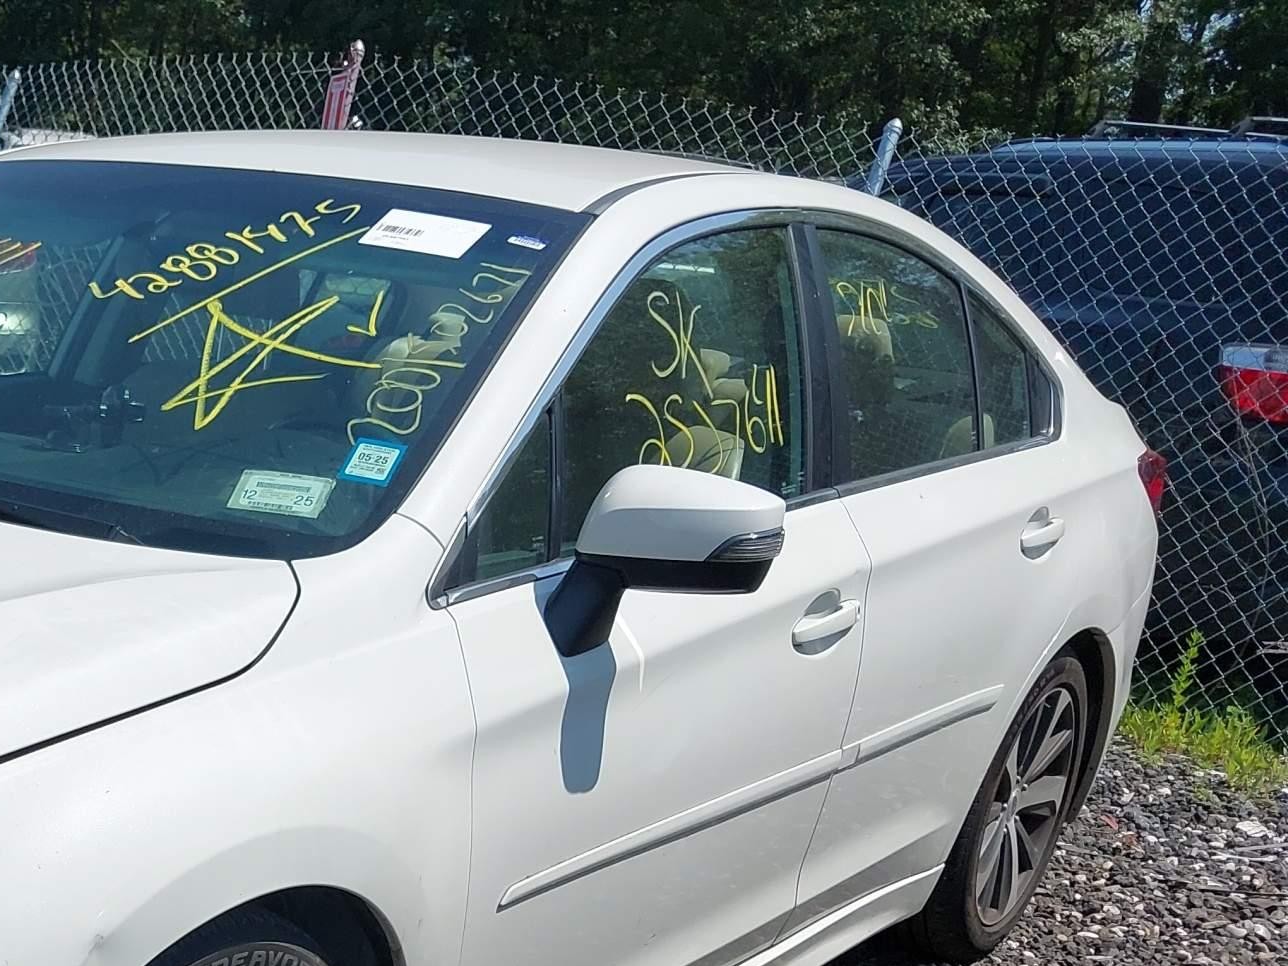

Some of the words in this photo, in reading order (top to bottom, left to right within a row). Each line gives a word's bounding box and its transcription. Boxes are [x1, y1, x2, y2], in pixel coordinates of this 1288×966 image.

[88, 198, 363, 300] 42881475
[646, 289, 715, 400] SK
[243, 488, 258, 500] 12
[293, 495, 315, 507] 25
